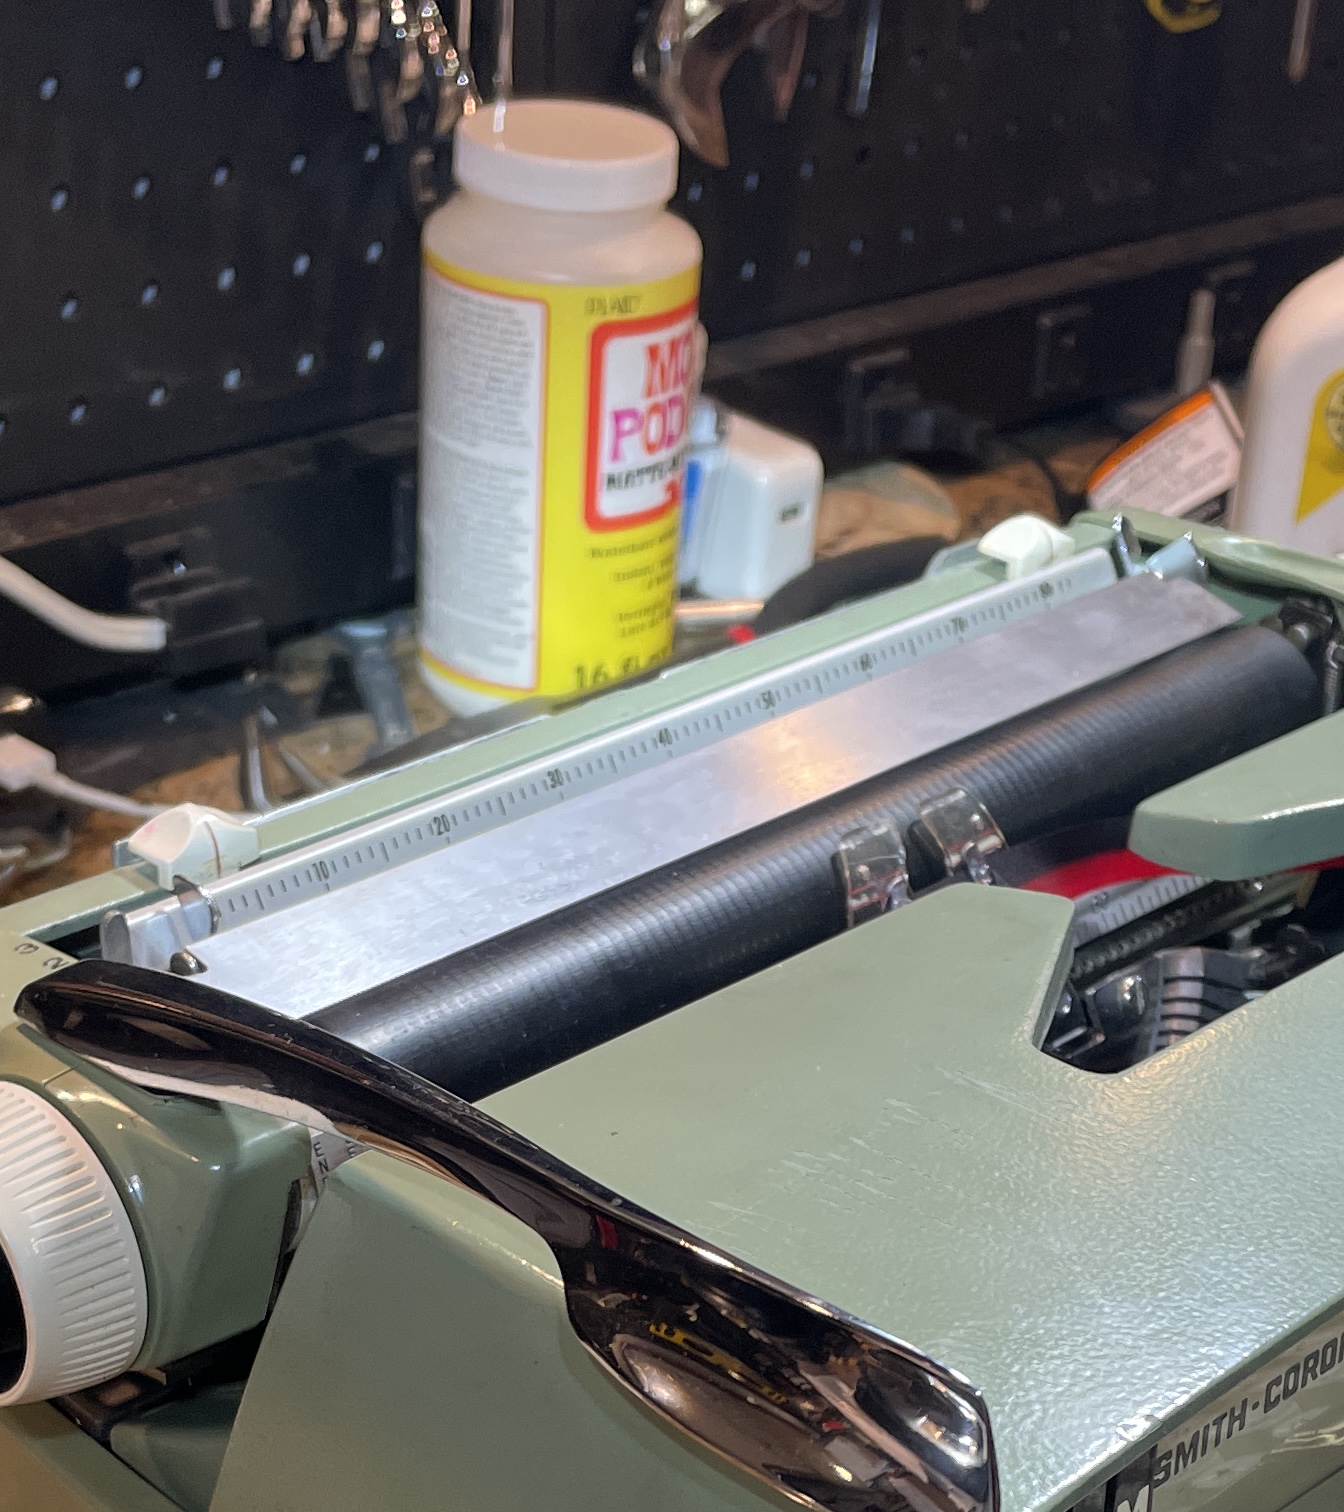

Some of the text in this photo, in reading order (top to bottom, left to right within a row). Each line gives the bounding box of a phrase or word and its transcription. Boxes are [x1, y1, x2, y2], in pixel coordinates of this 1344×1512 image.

[547, 767, 564, 790] 30
[434, 814, 451, 837] 20
[313, 861, 330, 882] 10
